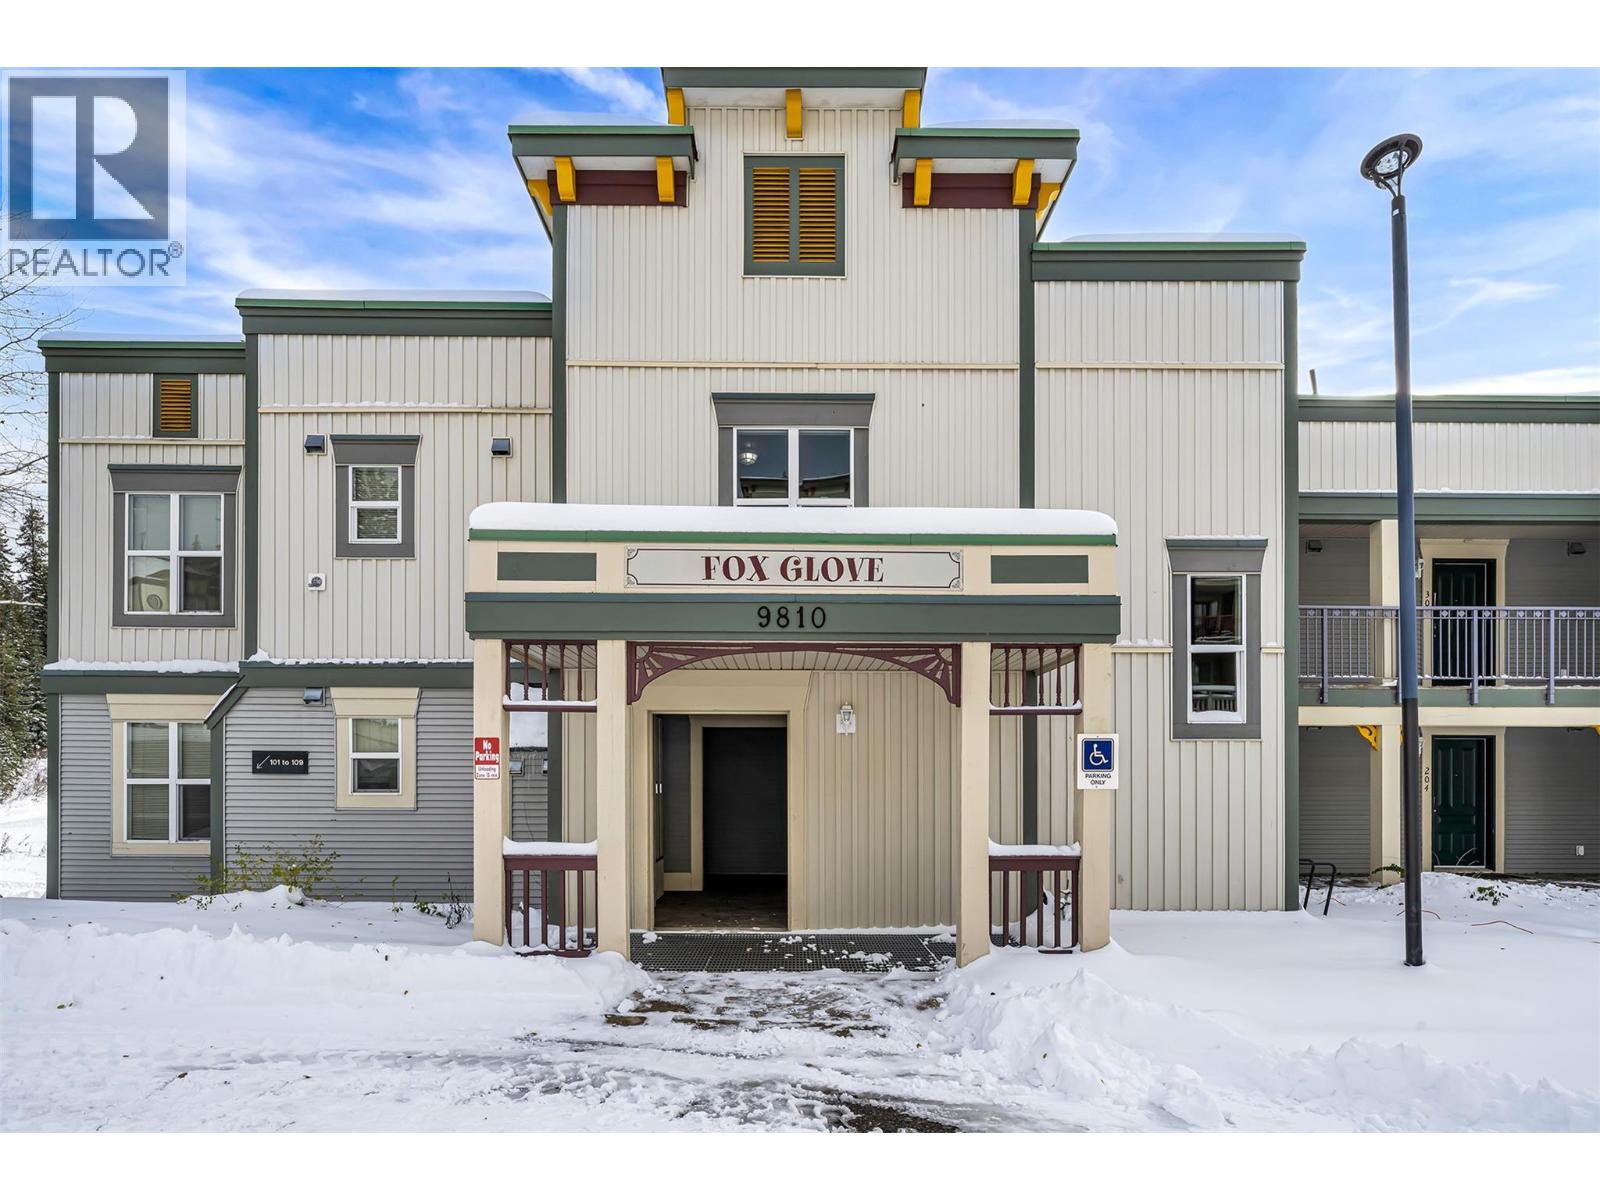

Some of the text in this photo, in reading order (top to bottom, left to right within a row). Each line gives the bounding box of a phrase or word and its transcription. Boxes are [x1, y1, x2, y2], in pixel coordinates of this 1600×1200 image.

[701, 555, 884, 582] FOX GLOVE
[757, 605, 826, 629] 9810
[482, 740, 492, 750] No
[475, 750, 500, 763] Parking
